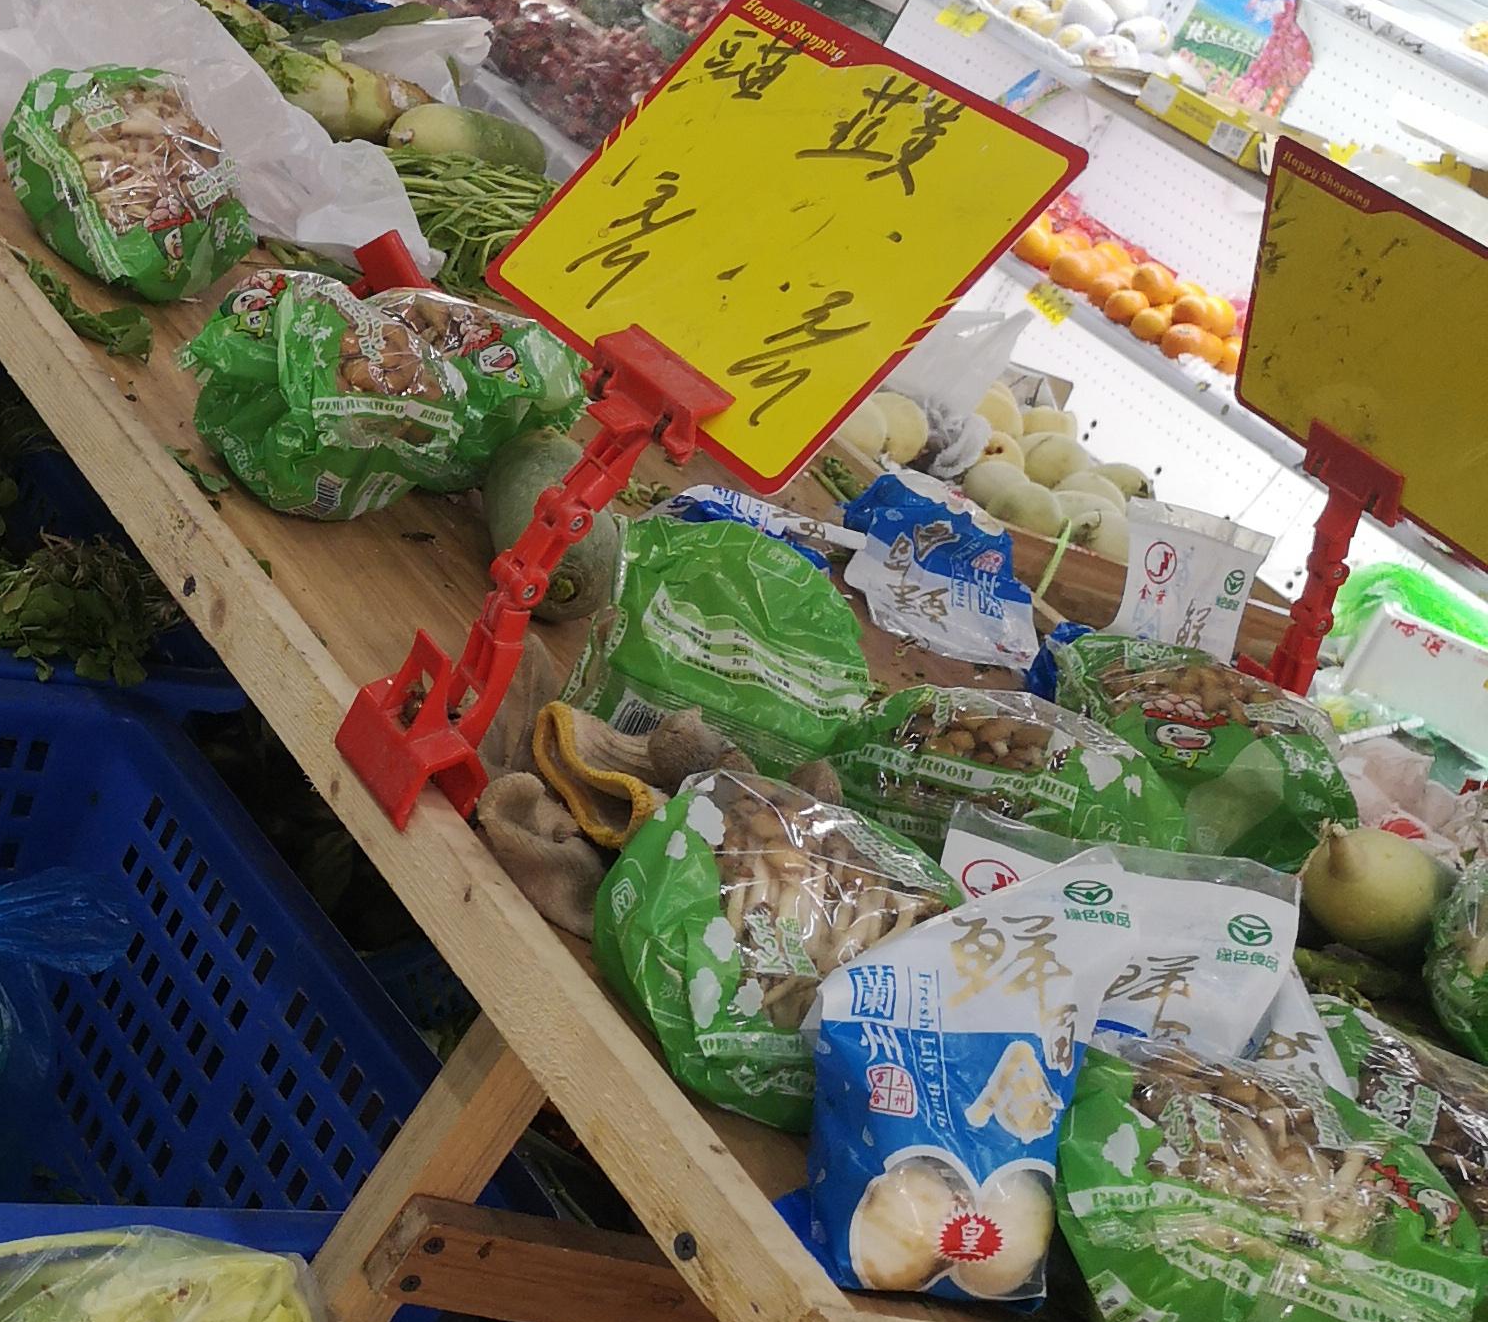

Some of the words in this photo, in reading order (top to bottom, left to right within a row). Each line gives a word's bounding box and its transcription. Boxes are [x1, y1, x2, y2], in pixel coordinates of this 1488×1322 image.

[784, 20, 847, 62] Shopping
[1282, 150, 1319, 181] Happy
[1319, 171, 1371, 209] Shopping
[1063, 907, 1132, 929] 绿色食品
[1215, 946, 1280, 973] 绿色食品
[917, 972, 936, 1030] Fresh
[917, 1034, 937, 1074] Lily
[928, 1078, 949, 1128] Bulb
